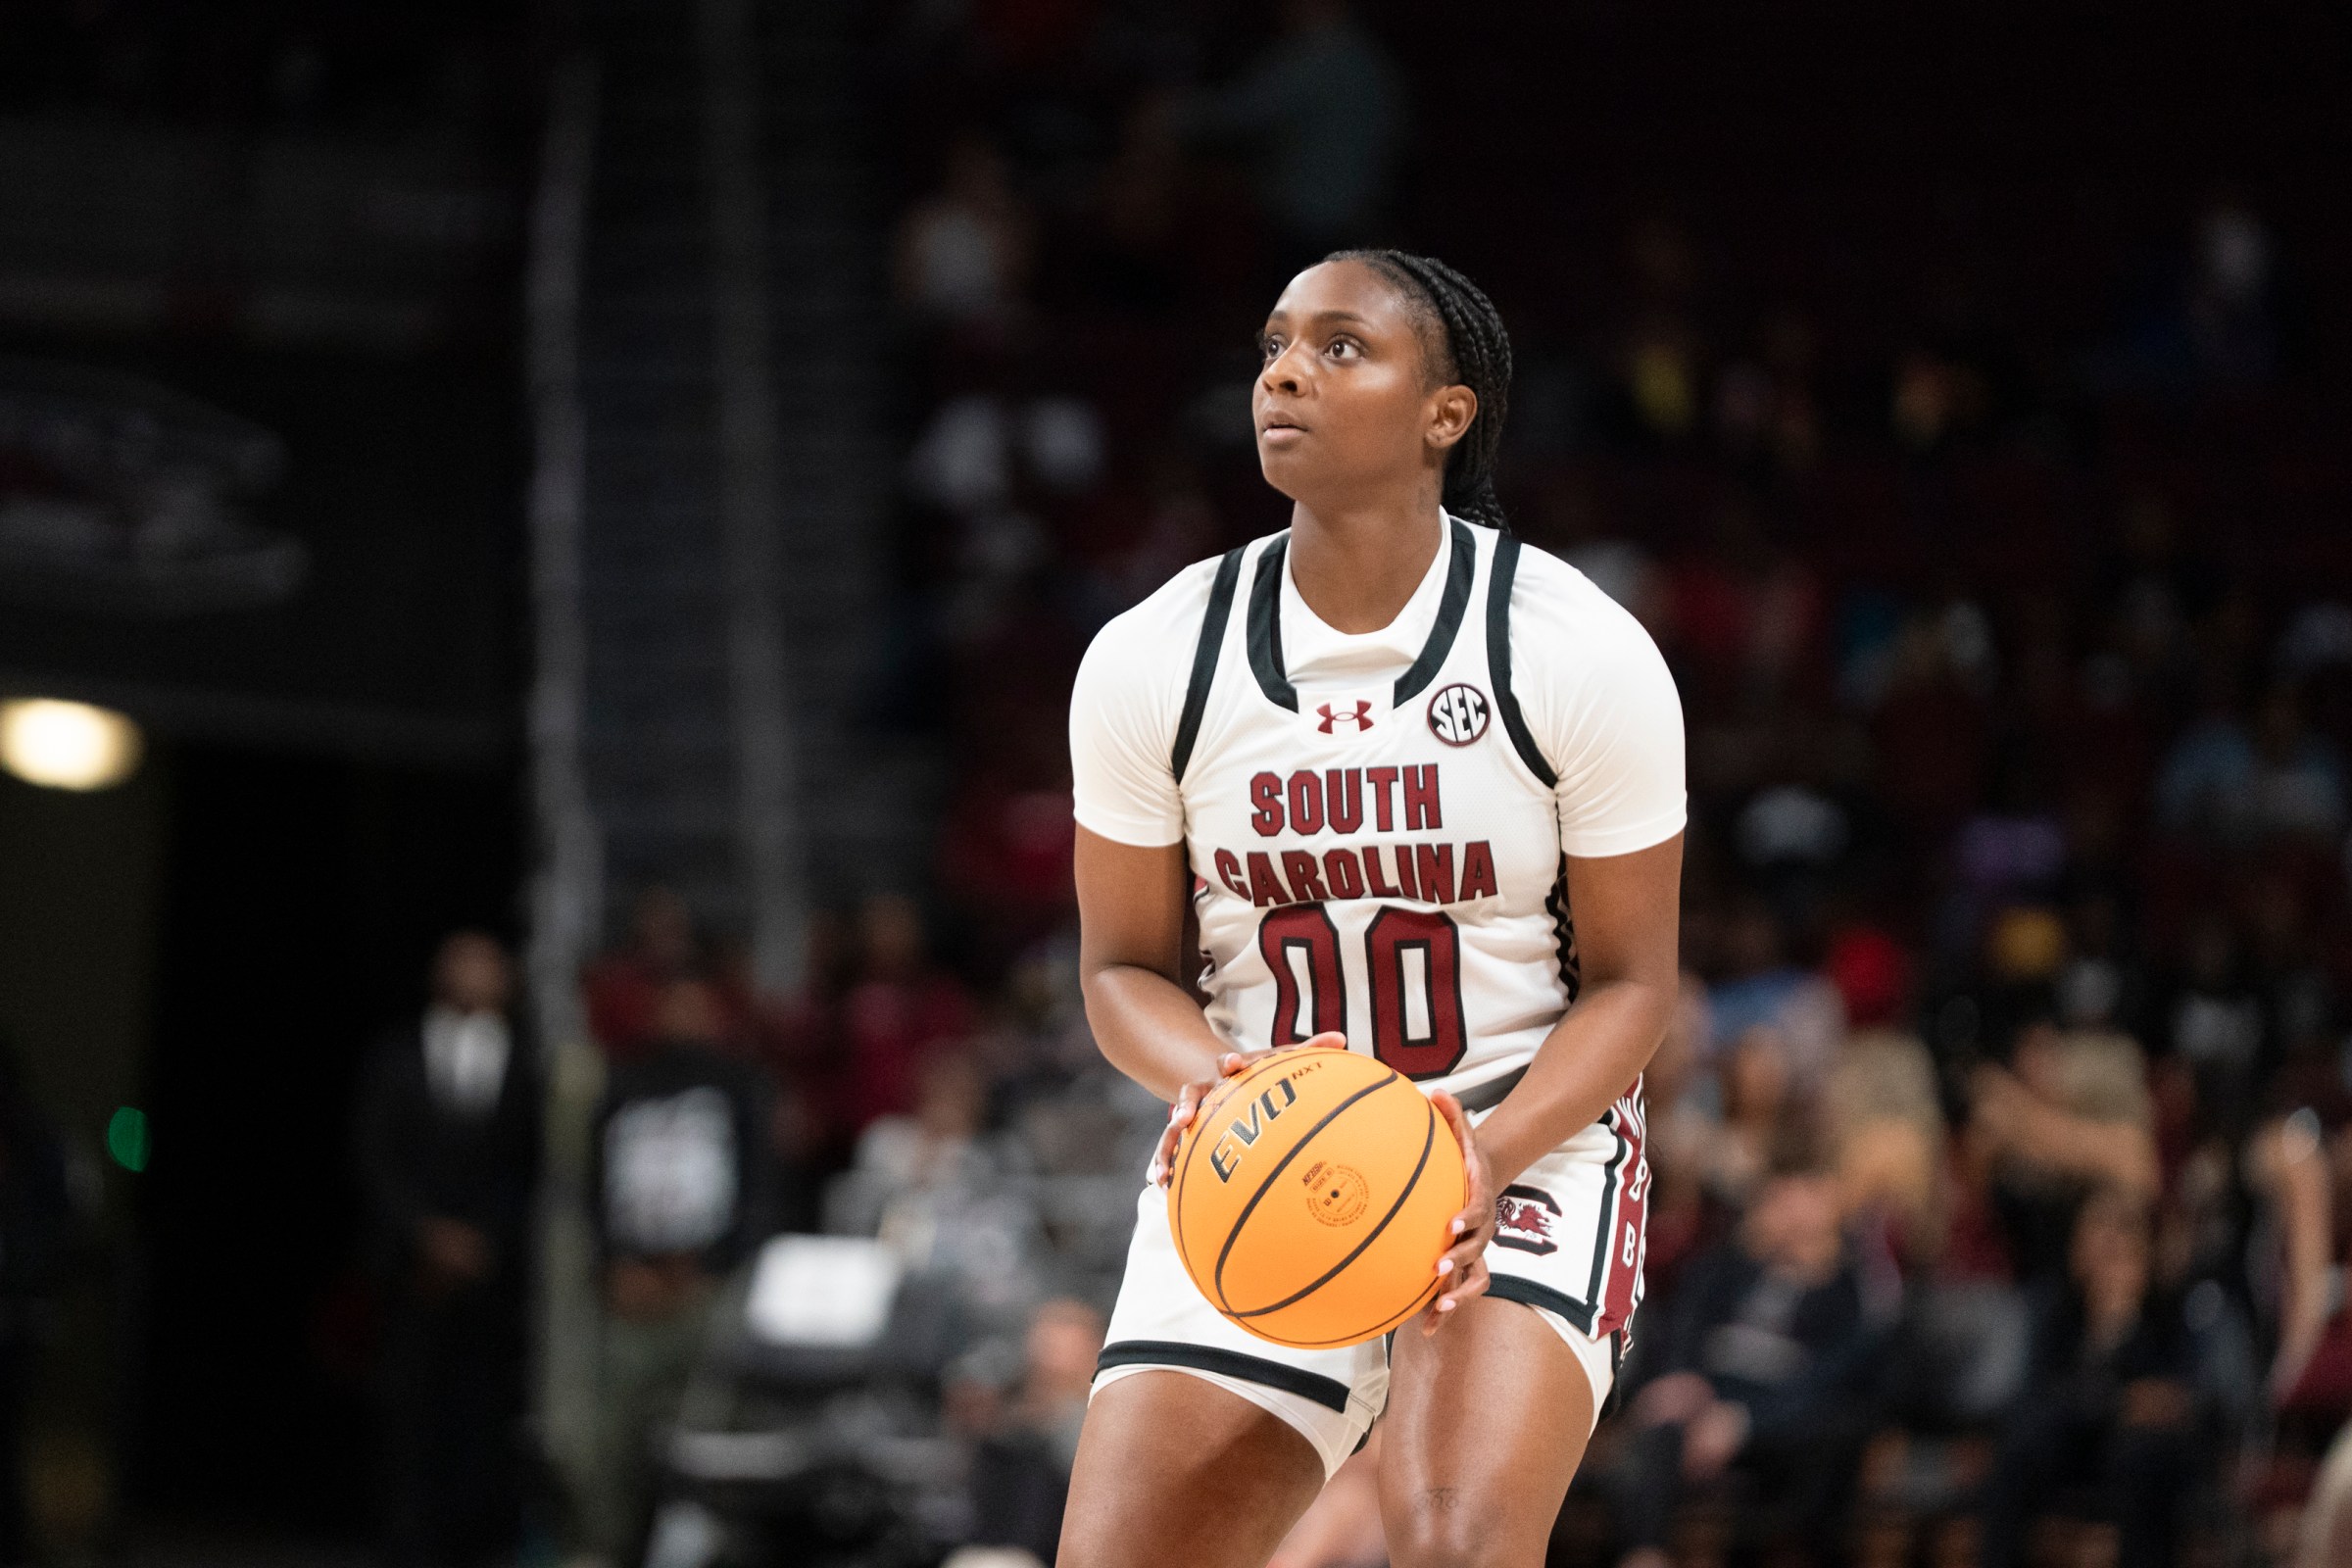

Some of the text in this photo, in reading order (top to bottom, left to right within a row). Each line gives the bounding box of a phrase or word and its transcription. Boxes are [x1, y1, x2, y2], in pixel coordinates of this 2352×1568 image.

[1431, 686, 1487, 743] SEC
[1250, 762, 1443, 837] SOUTH
[1213, 840, 1498, 907] CAROLINA
[1258, 901, 1468, 1079] 00
[1210, 1061, 1323, 1184] EVO NXT
